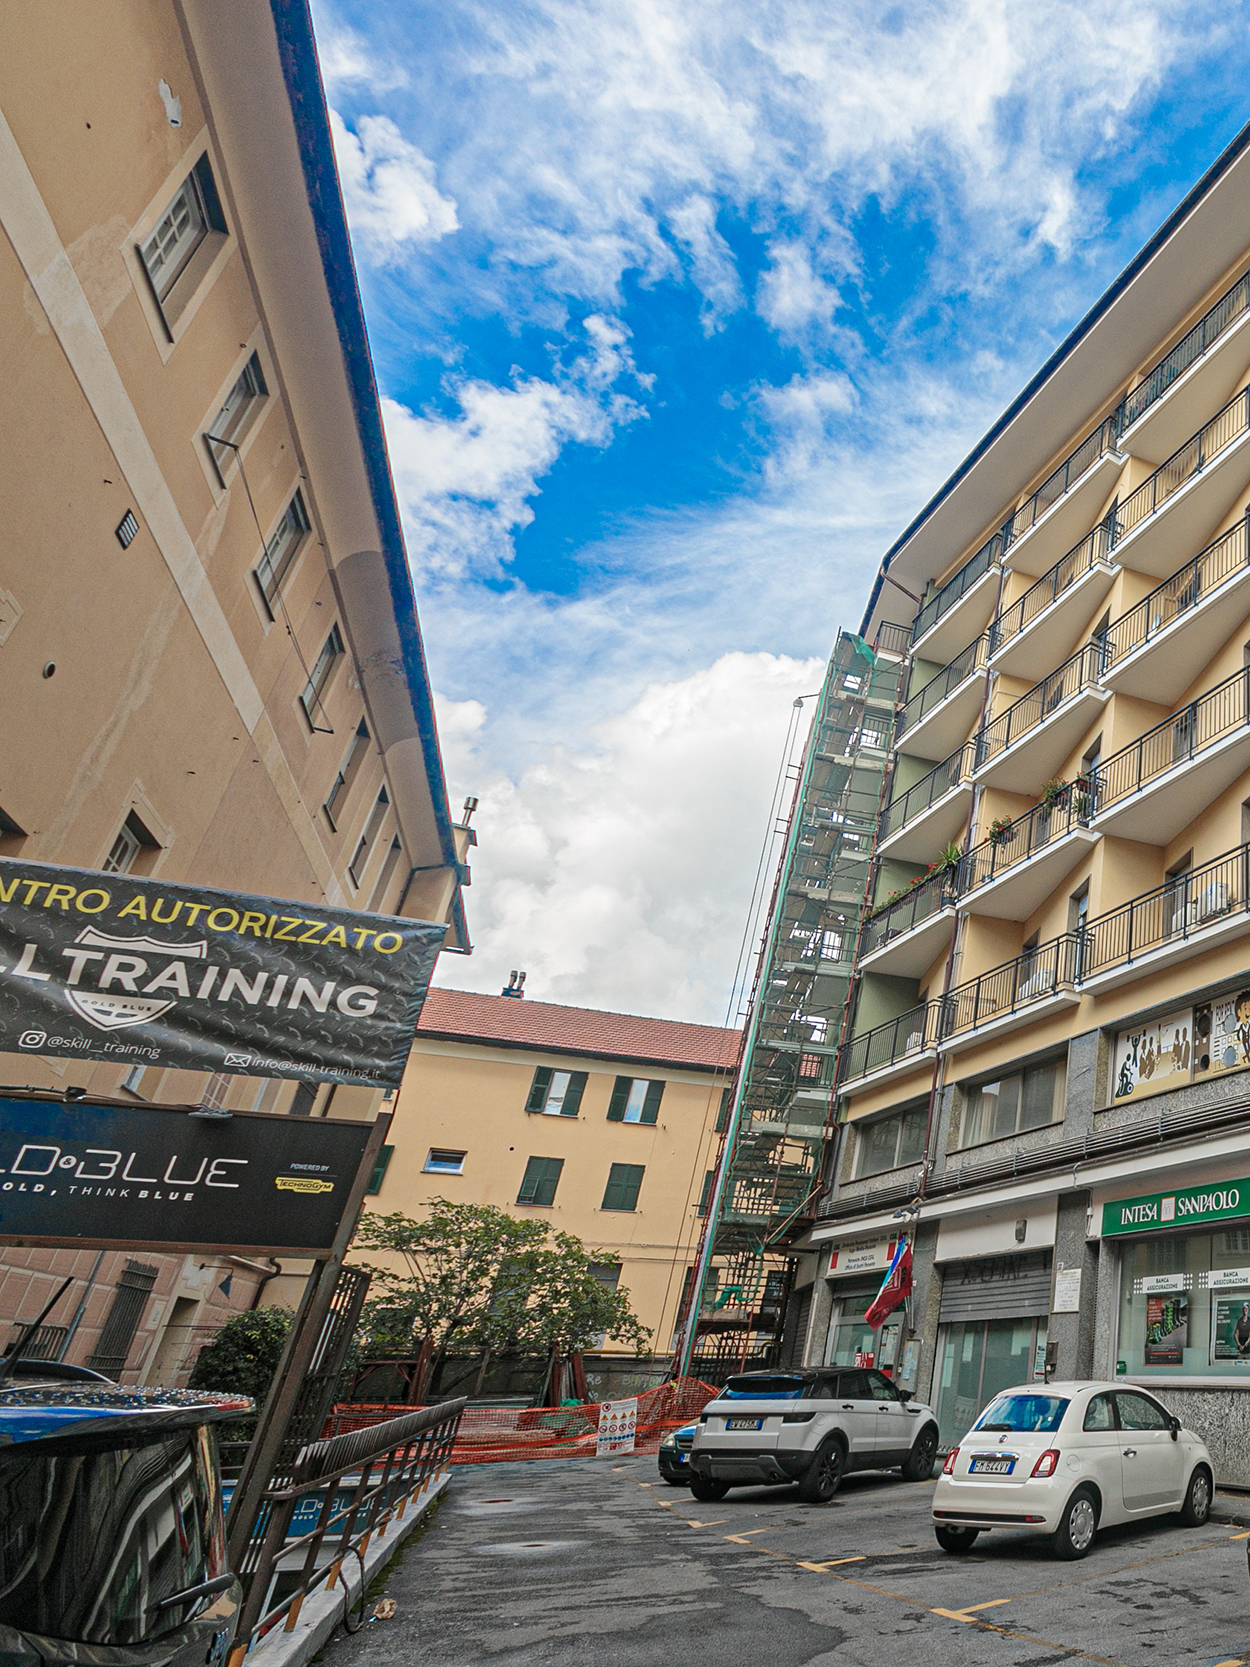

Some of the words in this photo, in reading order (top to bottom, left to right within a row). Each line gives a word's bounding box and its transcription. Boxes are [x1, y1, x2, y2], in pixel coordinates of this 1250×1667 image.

[117, 896, 403, 954] AUTORIZZATO
[62, 948, 380, 1018] TRAINING
[122, 1004, 152, 1012] BLUE
[252, 1057, 380, 1079] info@skill-training.it
[290, 1163, 320, 1171] POWERED
[69, 1185, 130, 1197] THINK
[138, 1189, 194, 1201] BLUE
[1121, 1203, 1158, 1225] INTESA
[1177, 1188, 1240, 1217] SANPAOLO
[1147, 1283, 1178, 1291] ASSICURAZIONE
[1213, 1276, 1249, 1285] ASSICURAZIONE
